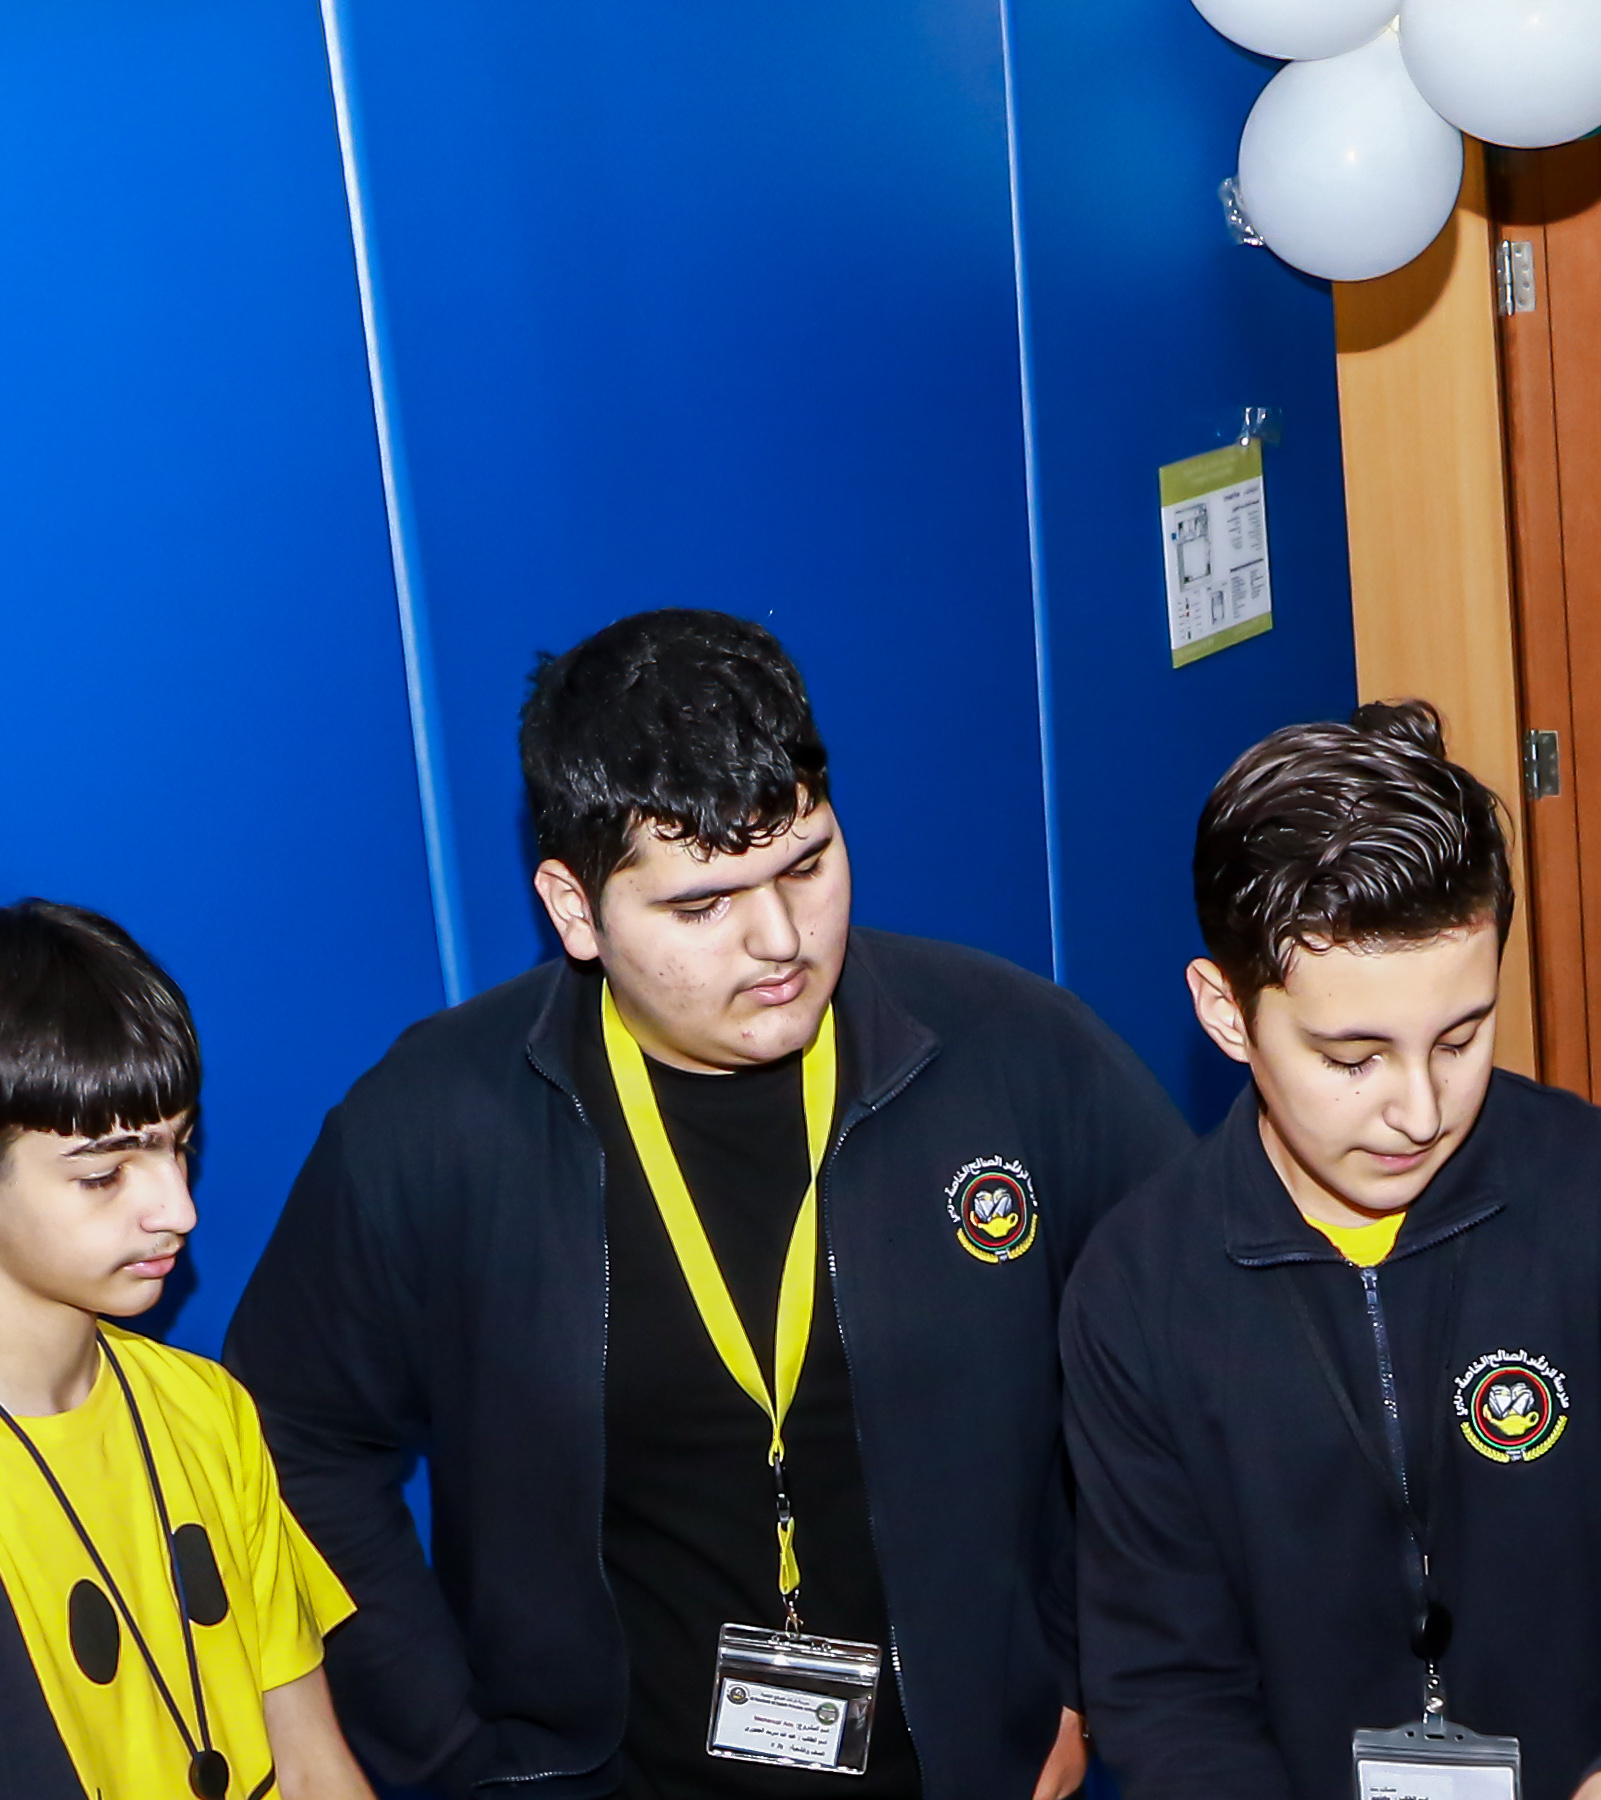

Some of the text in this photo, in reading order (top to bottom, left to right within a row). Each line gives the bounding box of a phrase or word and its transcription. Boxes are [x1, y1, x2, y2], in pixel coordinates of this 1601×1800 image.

[1453, 1354, 1490, 1389] الخاصة
[1488, 1349, 1527, 1368] الصالح
[1452, 1394, 1469, 1417] دبي
[1553, 1372, 1571, 1410] مدرسة
